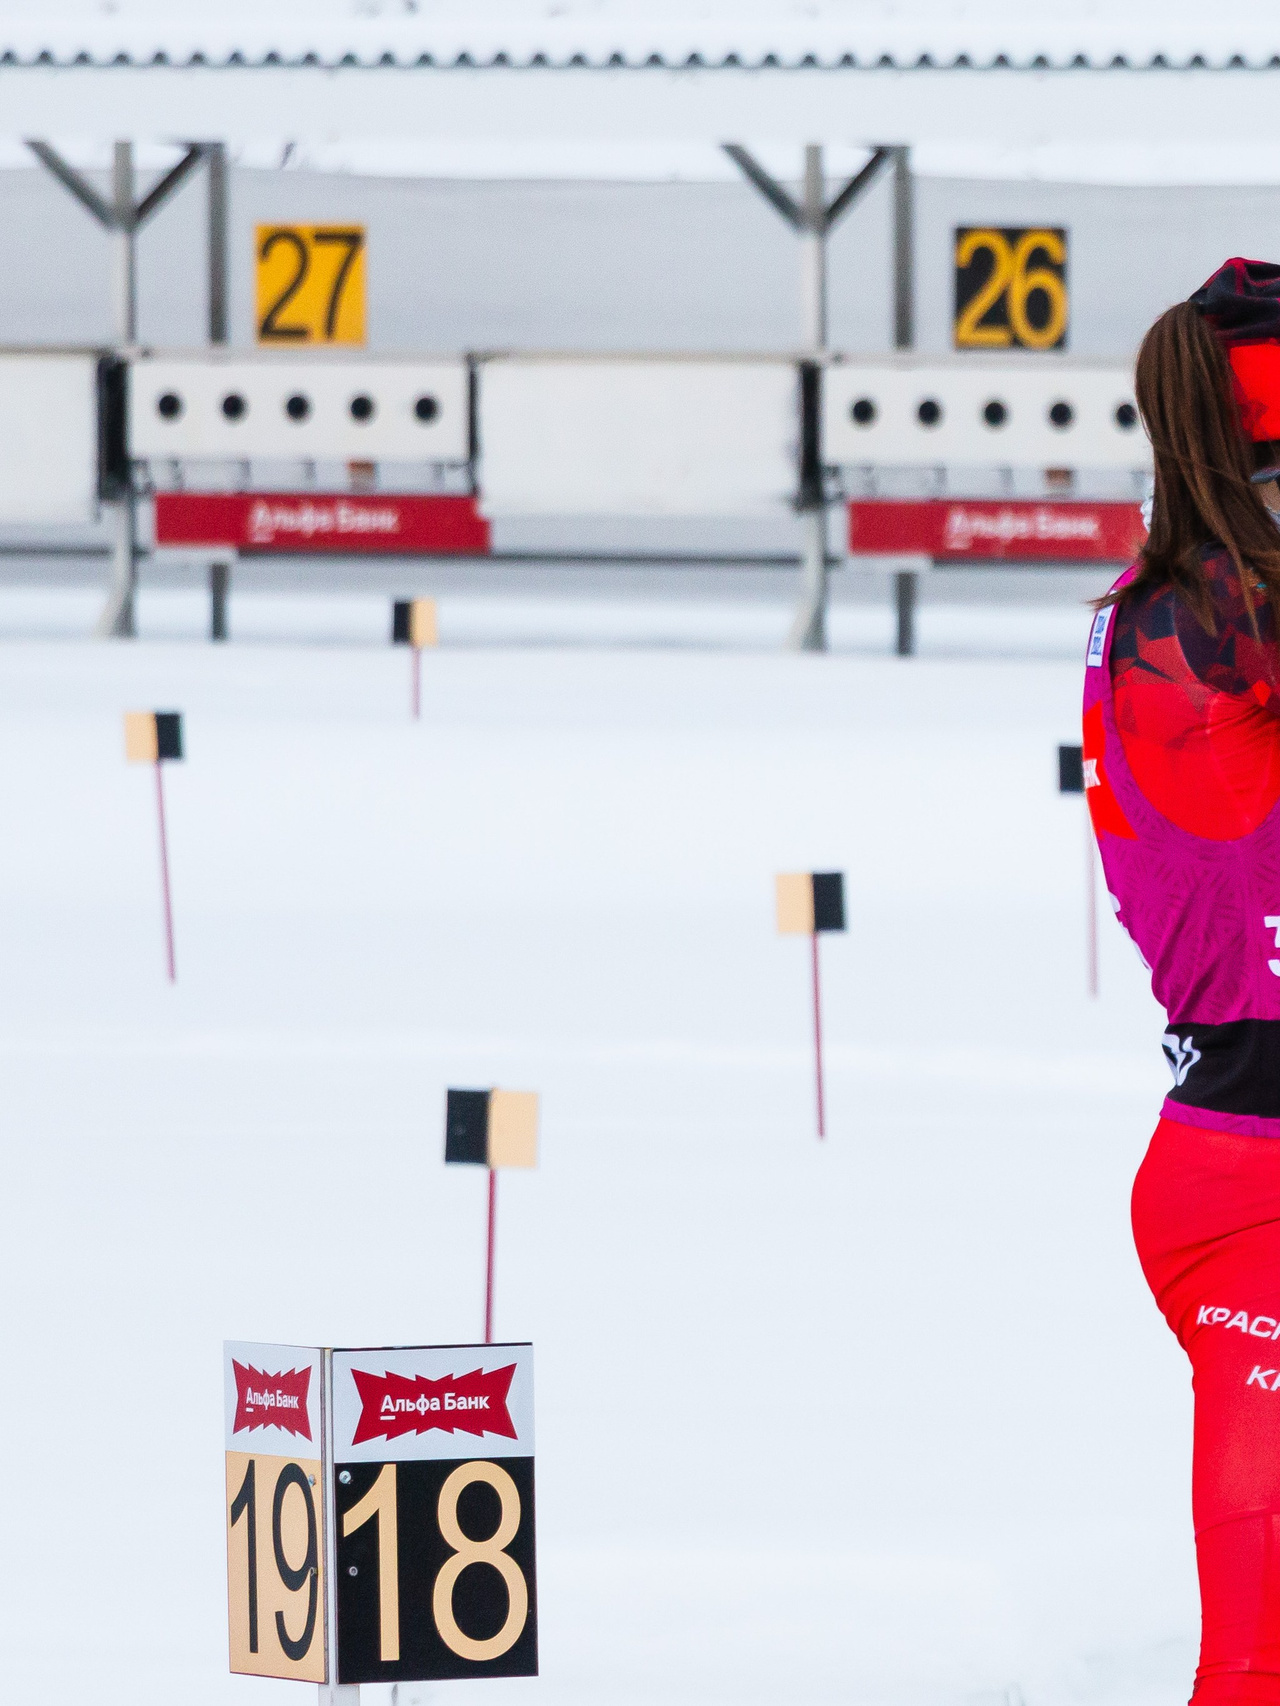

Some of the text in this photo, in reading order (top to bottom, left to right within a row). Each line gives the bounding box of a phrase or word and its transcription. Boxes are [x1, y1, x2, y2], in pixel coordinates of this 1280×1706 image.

[260, 228, 363, 341] 27
[956, 228, 1067, 350] 26
[245, 1386, 300, 1413] Альфа Банк
[379, 1391, 491, 1421] Альфа Банк
[230, 1459, 319, 1662] 19
[343, 1460, 529, 1662] 18
